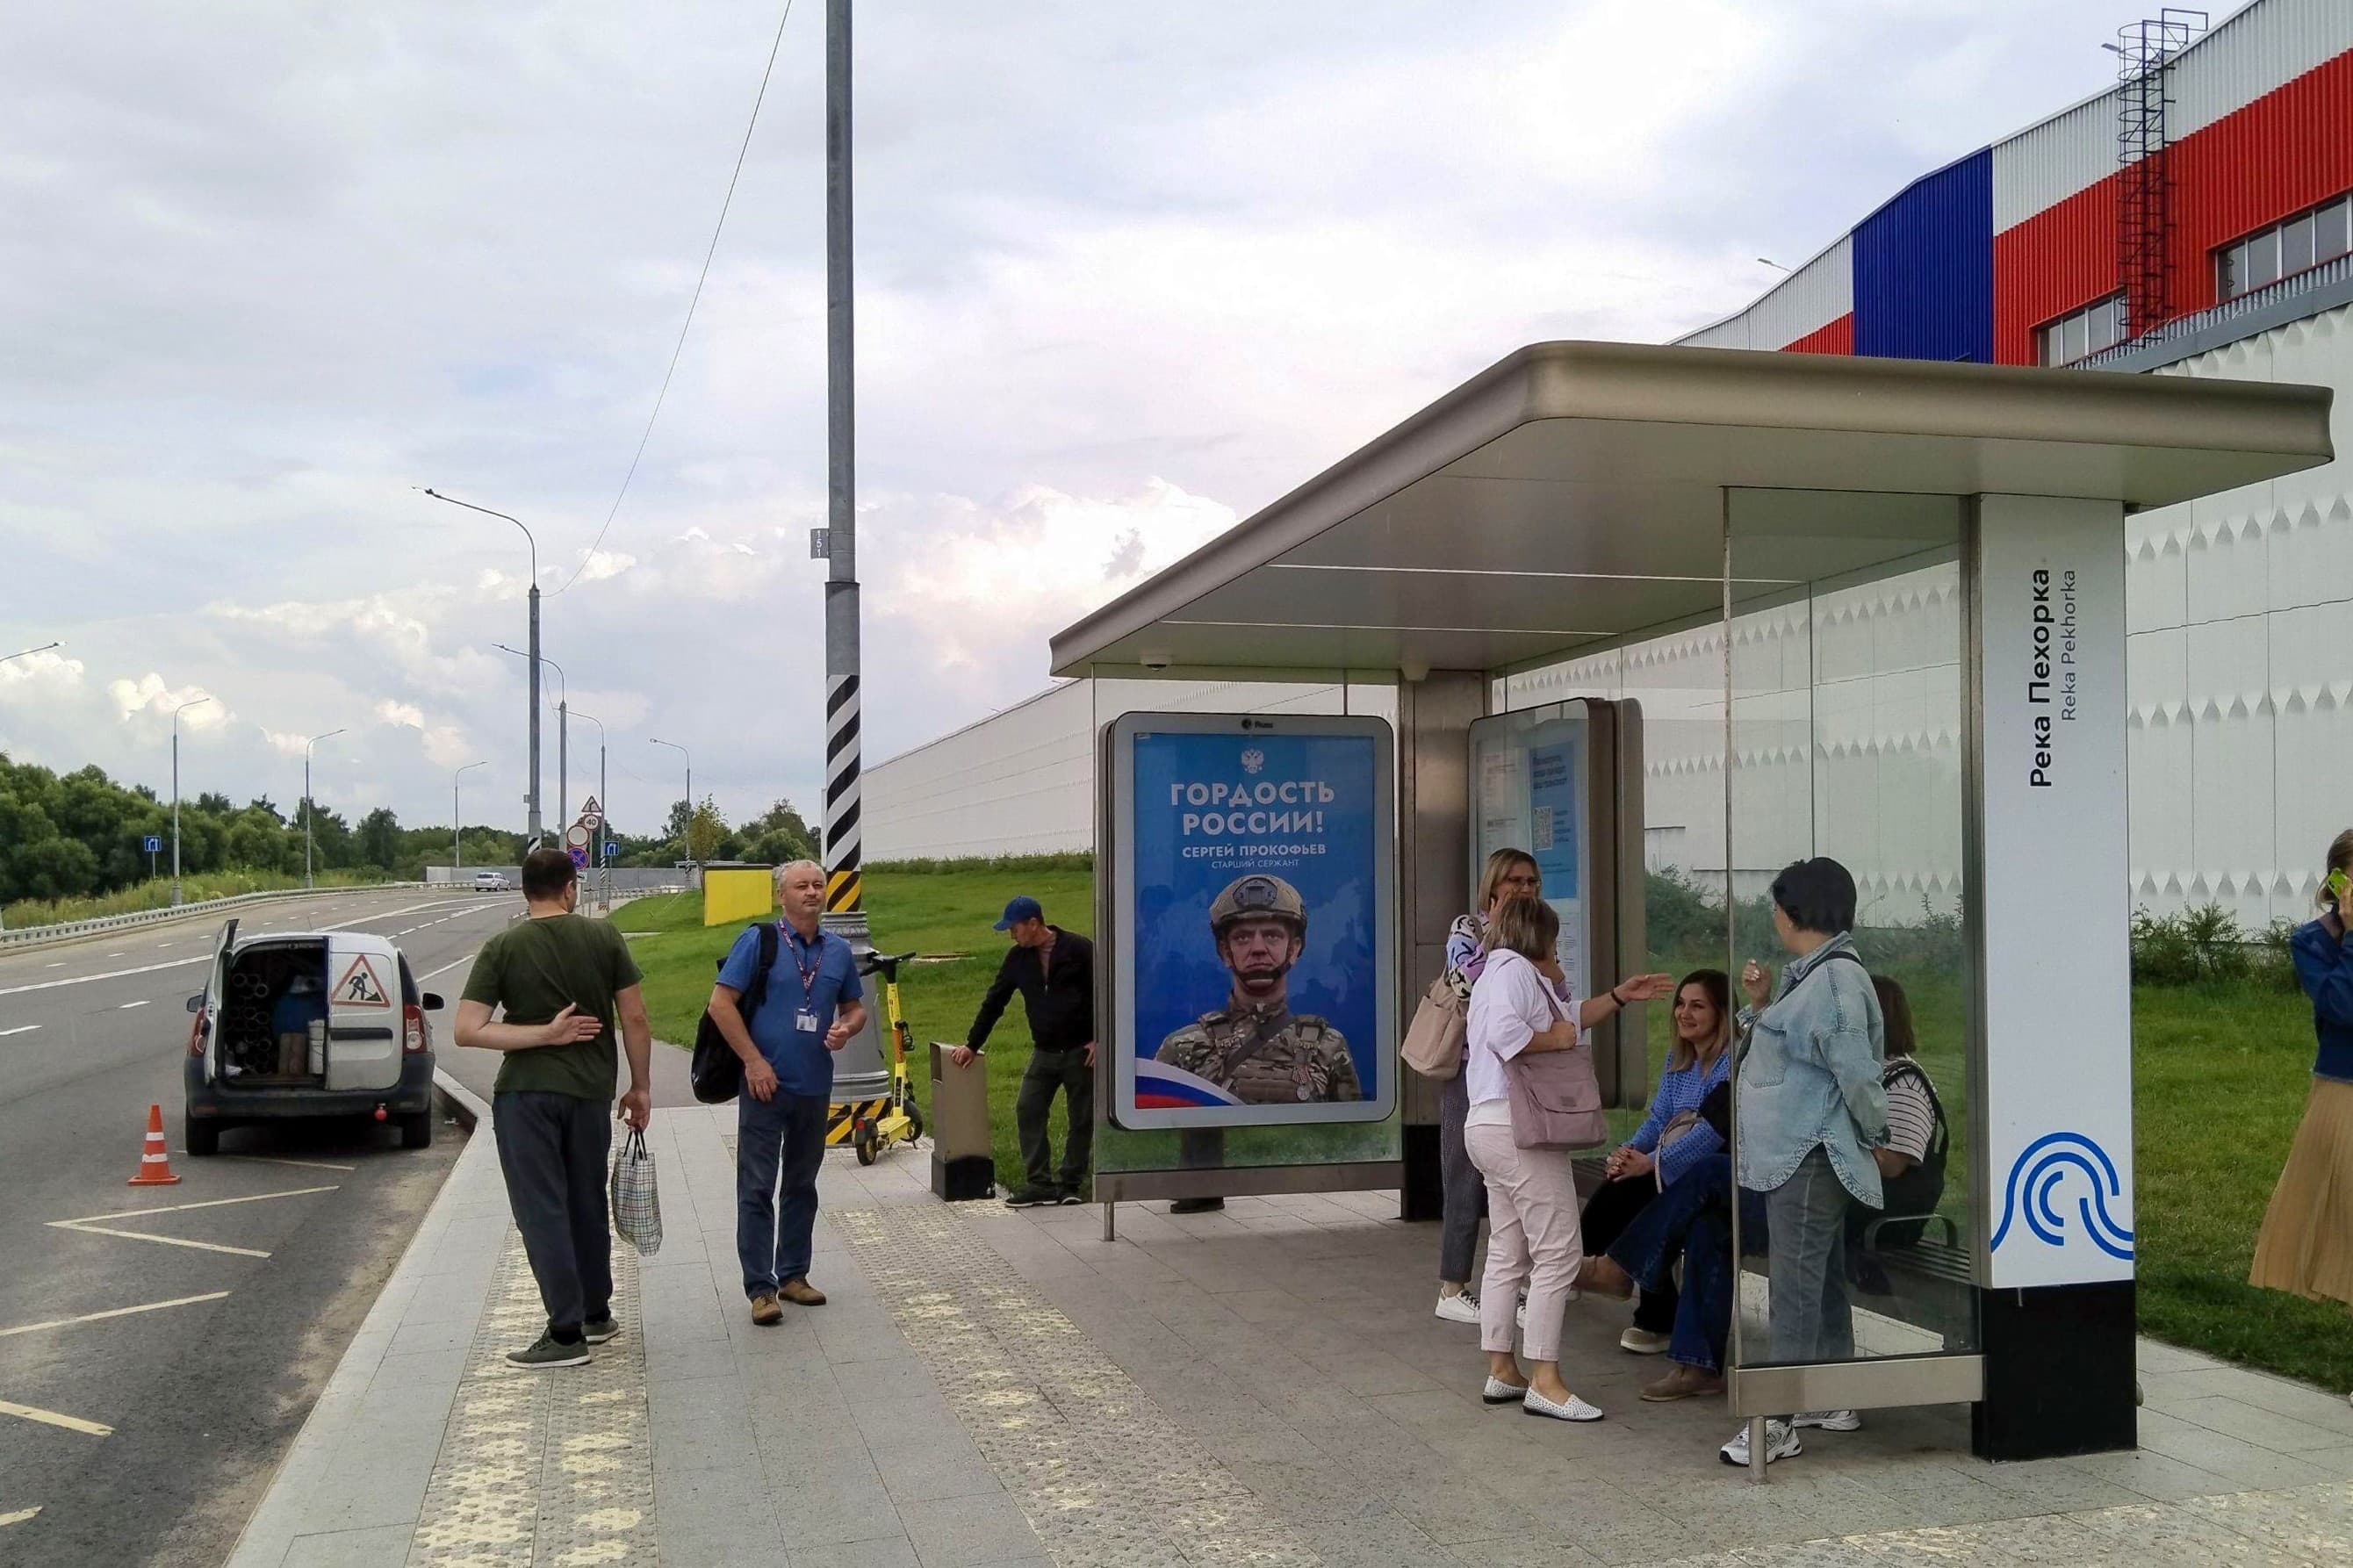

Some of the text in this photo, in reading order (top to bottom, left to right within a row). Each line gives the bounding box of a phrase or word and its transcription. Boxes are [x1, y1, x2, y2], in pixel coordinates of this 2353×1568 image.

[2060, 571, 2076, 721] Reka Pekhorka
[2028, 569, 2054, 788] Река Пехорка
[1170, 781, 1335, 808] ГОРДОСТЬ
[1183, 811, 1323, 835] РОССИИ!
[1182, 844, 1327, 858] СЕРГЕЙ ПРОКОФЬЕВ
[1212, 859, 1300, 869] СТАРШИЙ СЕРЖАНТ
